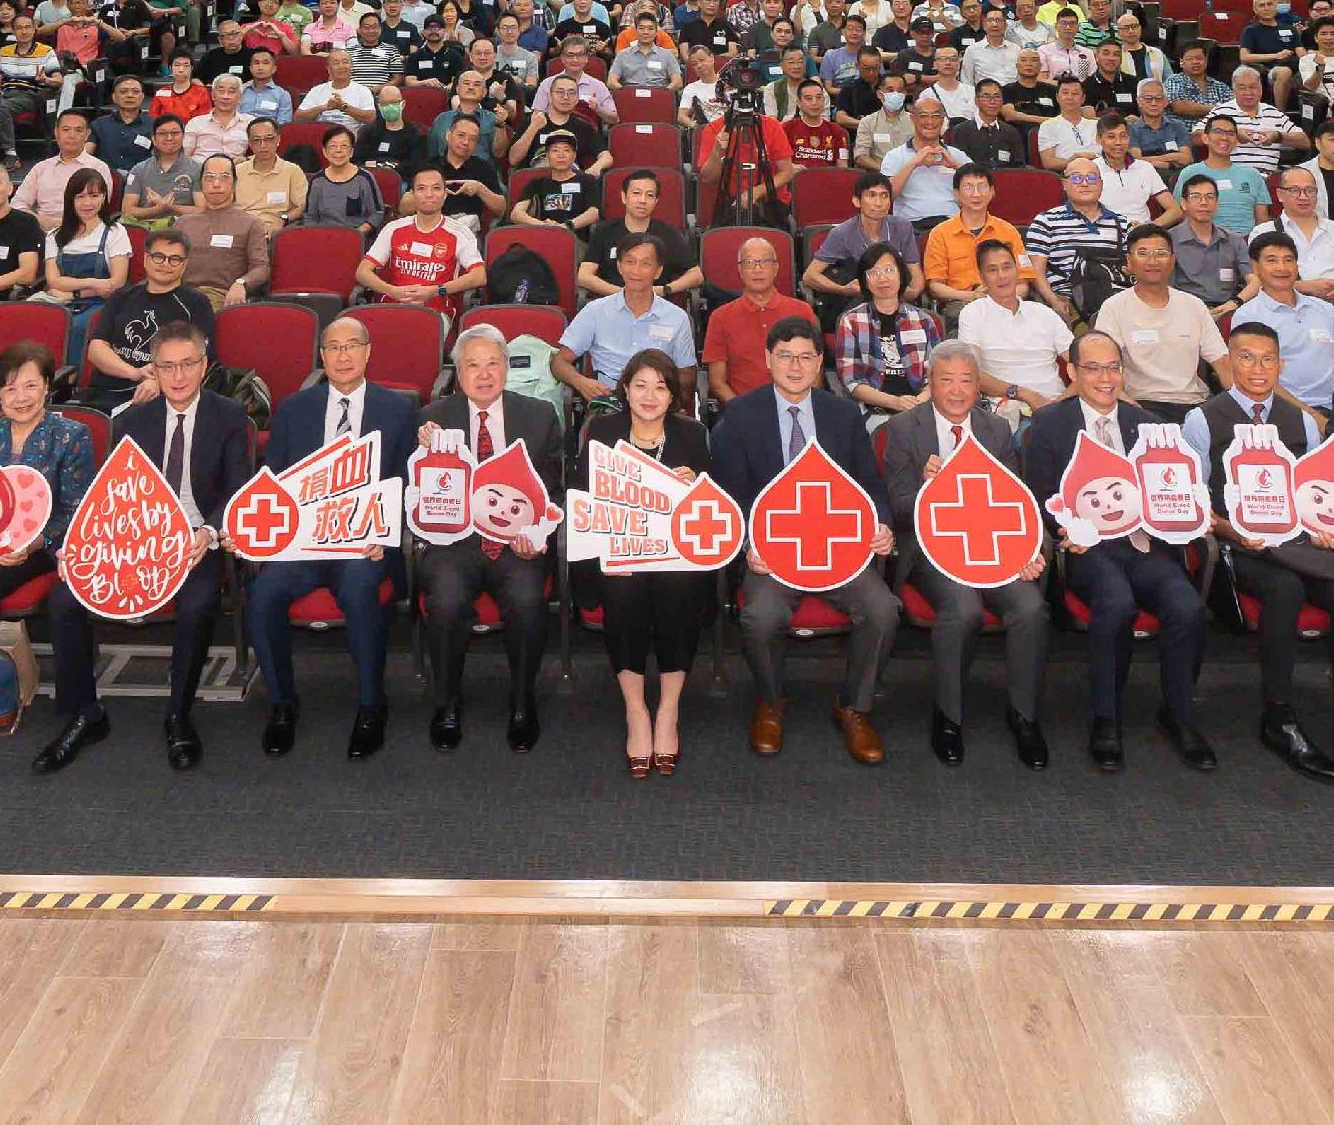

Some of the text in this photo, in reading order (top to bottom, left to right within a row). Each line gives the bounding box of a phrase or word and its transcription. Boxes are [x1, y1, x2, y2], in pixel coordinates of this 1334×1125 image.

[795, 152, 828, 160] Chartered
[798, 146, 827, 155] Standard
[396, 256, 445, 272] Emirates
[299, 442, 370, 505] 捐血
[594, 444, 641, 482] GIVE
[100, 471, 156, 515] save
[594, 469, 672, 514] BLOOD
[80, 500, 179, 541] lives by
[312, 491, 388, 542] 救人
[574, 498, 647, 536] SAVE
[72, 530, 188, 579] giving
[609, 536, 668, 556] LIVES
